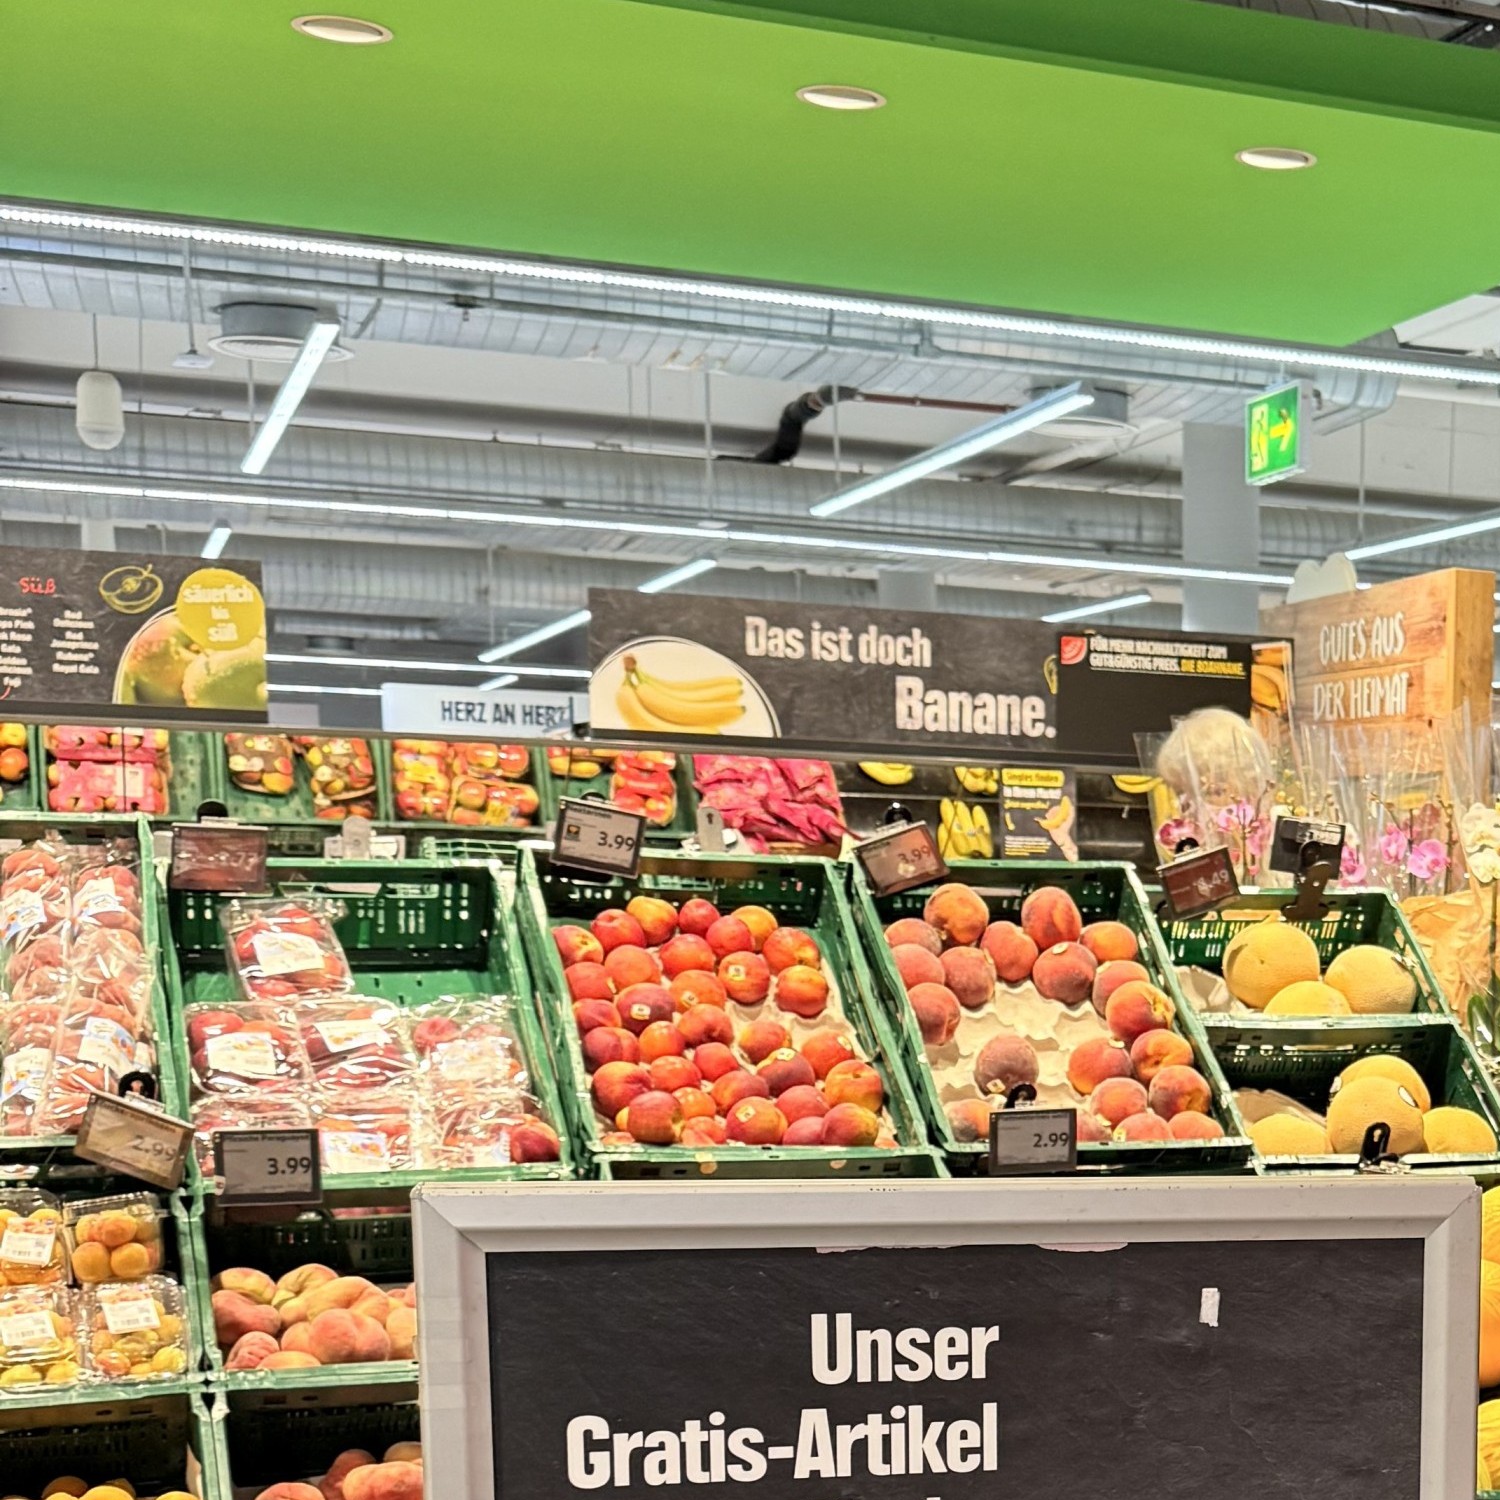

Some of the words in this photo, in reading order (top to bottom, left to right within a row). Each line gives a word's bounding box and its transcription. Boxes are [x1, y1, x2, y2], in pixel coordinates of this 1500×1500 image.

[744, 615, 805, 659] Das
[811, 620, 854, 663] ist
[858, 625, 932, 668] doch
[1319, 617, 1367, 666] GUTES
[1371, 611, 1405, 659] AUS
[440, 699, 487, 723] HERZ
[492, 703, 516, 725] AN
[894, 675, 1057, 739] Banane.
[1313, 681, 1345, 722] DER
[1350, 672, 1410, 720] HEIMAT
[597, 830, 636, 852] 3.99
[1032, 1132, 1069, 1148] 2.99
[267, 1156, 312, 1176] 3.99
[810, 1312, 1000, 1385] Unser
[566, 1402, 998, 1490] Gratis-Artikel
